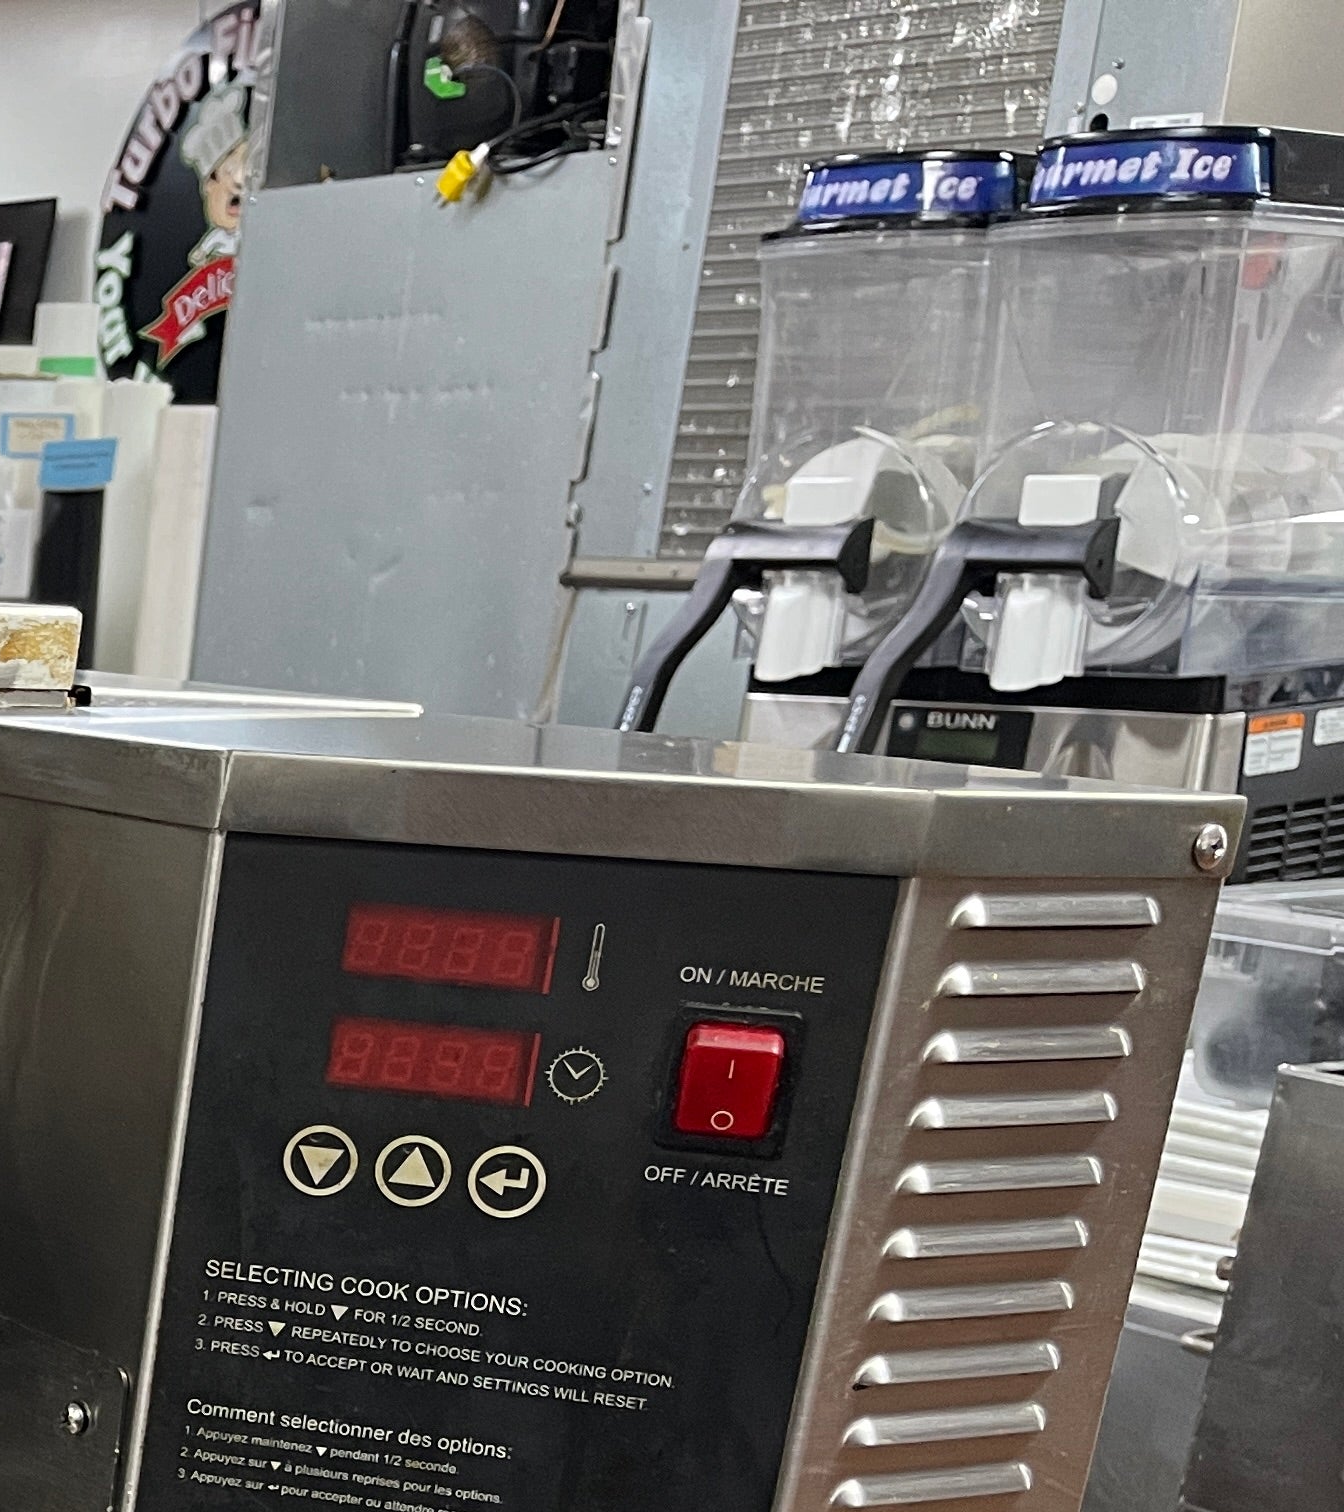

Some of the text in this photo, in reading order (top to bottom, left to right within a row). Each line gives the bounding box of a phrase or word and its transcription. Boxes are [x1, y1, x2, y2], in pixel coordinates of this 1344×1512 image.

[100, 52, 204, 213] Turbo
[1169, 147, 1233, 181] Ice
[95, 231, 134, 366] Your
[174, 268, 236, 327] Delic
[926, 711, 998, 731] BUNN
[680, 966, 713, 984] ON
[729, 970, 826, 994] MARCHE
[644, 1165, 687, 1184] OFF
[205, 1259, 529, 1317] SELECTING COOK OPTIONS:
[217, 1291, 268, 1310] PRESS
[270, 1298, 281, 1311] &
[284, 1301, 327, 1317] HOLD
[353, 1308, 387, 1325] FOR
[390, 1314, 412, 1328] 1/2
[413, 1317, 484, 1337] SECOND.
[210, 1340, 261, 1359] PRESS
[284, 1349, 305, 1364] TO
[305, 1353, 368, 1372] ACCEPT
[370, 1362, 393, 1377] OR
[397, 1365, 435, 1382] WAIT
[436, 1371, 470, 1387] AND
[472, 1375, 551, 1397] SETTINGS
[553, 1386, 591, 1404] WILL
[214, 1315, 265, 1334] PRESS
[291, 1325, 387, 1350] REPEATEDLY
[391, 1338, 412, 1354] TO
[414, 1342, 482, 1364] CHOOSE
[485, 1351, 530, 1370] YOUR
[532, 1358, 608, 1380] COOKING
[610, 1368, 676, 1390] OPTION.
[186, 1398, 276, 1426] Comment
[397, 1428, 433, 1449] des
[437, 1437, 514, 1461] options:
[196, 1426, 249, 1445] Appuyez
[250, 1435, 314, 1454] maintenez
[329, 1446, 380, 1465] pendant
[383, 1453, 402, 1467] 1/2
[190, 1470, 243, 1488] Appuyez
[245, 1478, 265, 1491] sur
[281, 1484, 310, 1497] pour
[310, 1488, 364, 1506] accepter
[365, 1498, 382, 1509] ou
[193, 1448, 246, 1467] Appuyez
[248, 1457, 268, 1469] sur
[294, 1463, 350, 1482] plusieurs
[352, 1472, 401, 1489] reprises
[402, 1480, 433, 1493] pour
[433, 1483, 453, 1497] les
